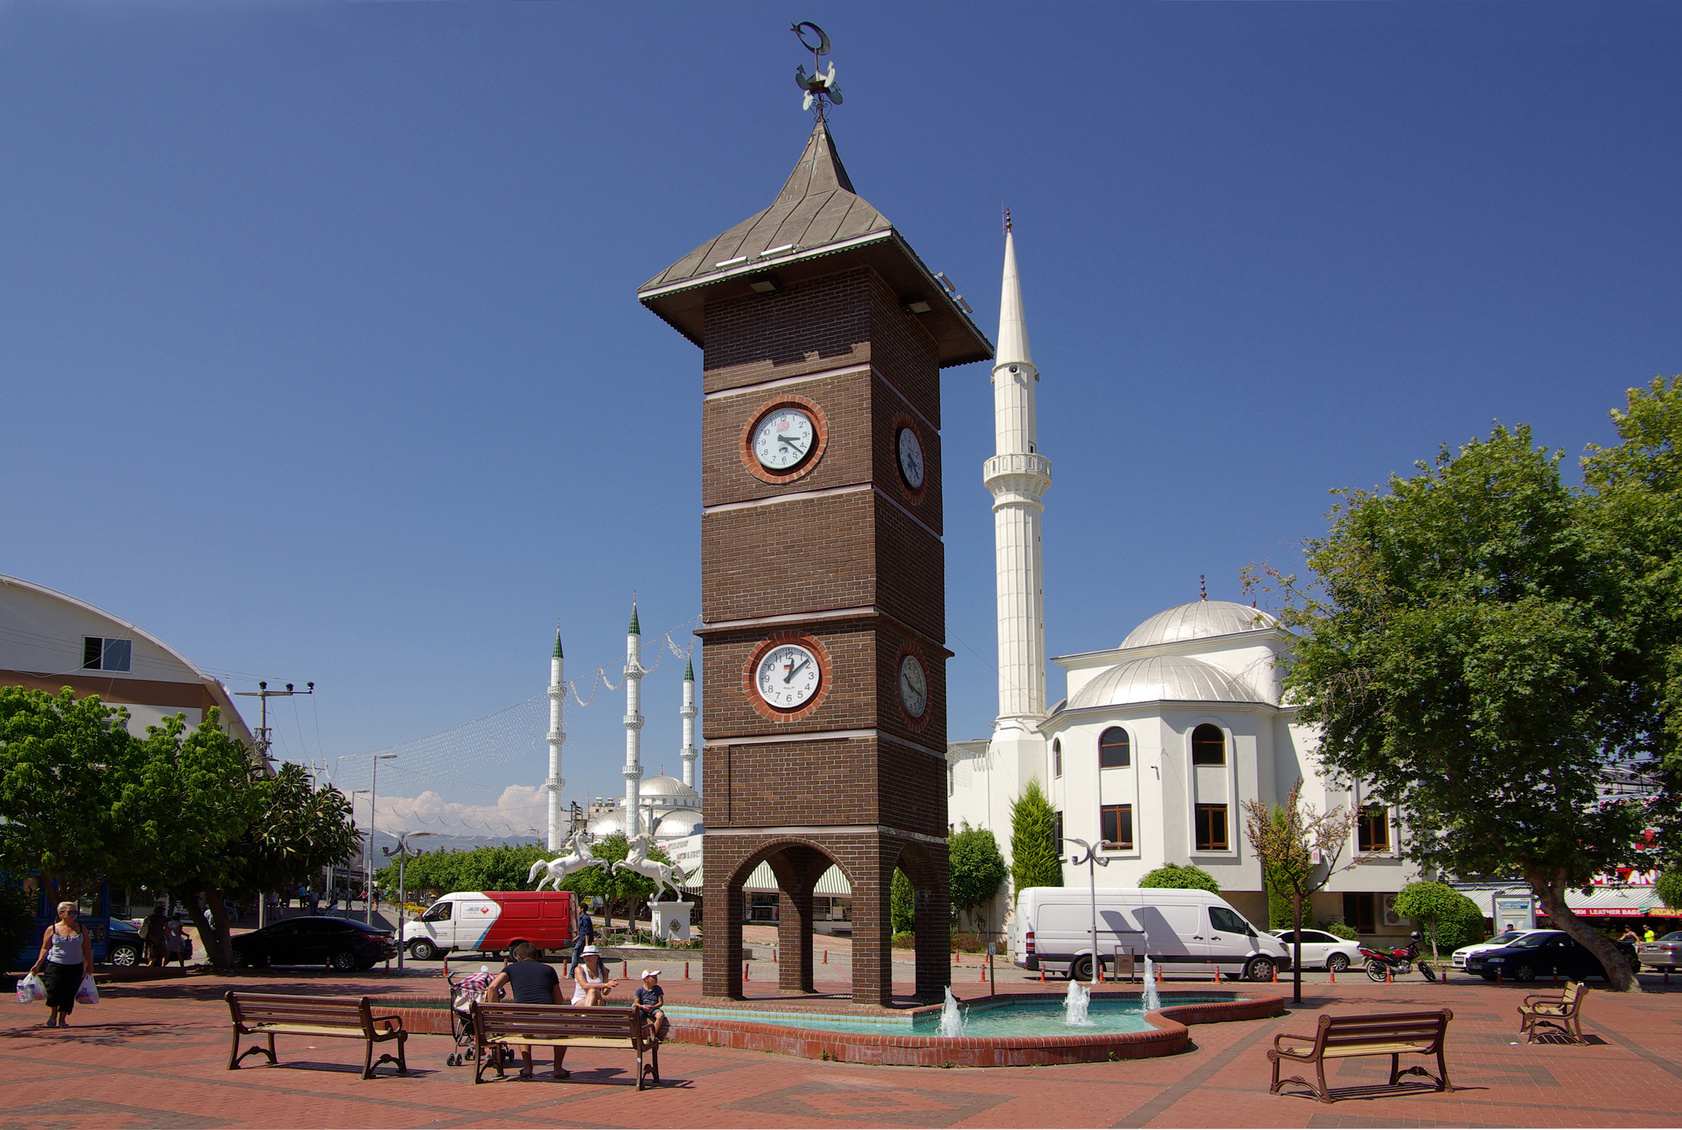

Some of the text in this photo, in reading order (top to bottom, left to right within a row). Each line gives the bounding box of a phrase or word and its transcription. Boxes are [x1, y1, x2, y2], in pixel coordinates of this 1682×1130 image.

[785, 651, 793, 659] 12
[805, 660, 811, 669] 2
[764, 675, 770, 683] 9
[808, 672, 814, 680] 3
[767, 685, 774, 693] 8
[786, 694, 792, 702] 6
[797, 690, 803, 698] 5
